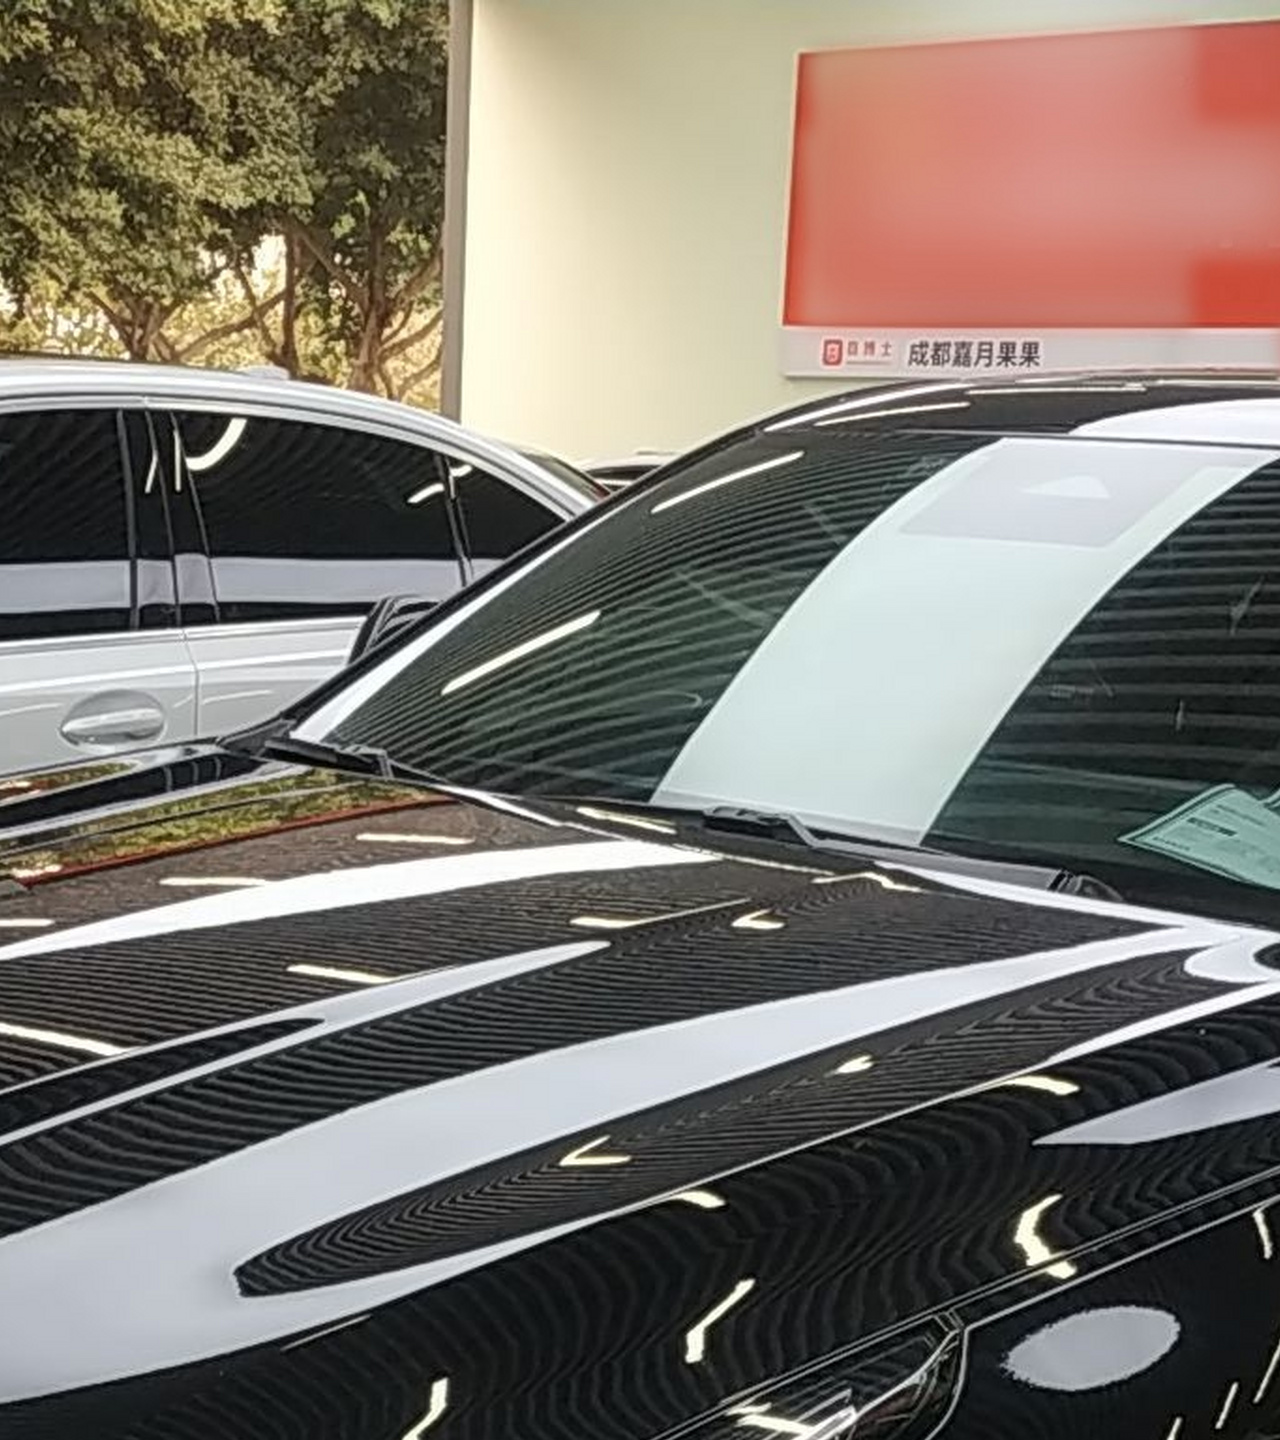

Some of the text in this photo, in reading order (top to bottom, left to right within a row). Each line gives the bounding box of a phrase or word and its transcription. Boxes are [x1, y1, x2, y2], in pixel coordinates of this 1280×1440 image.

[908, 340, 1041, 368] 成都嘉月果果
